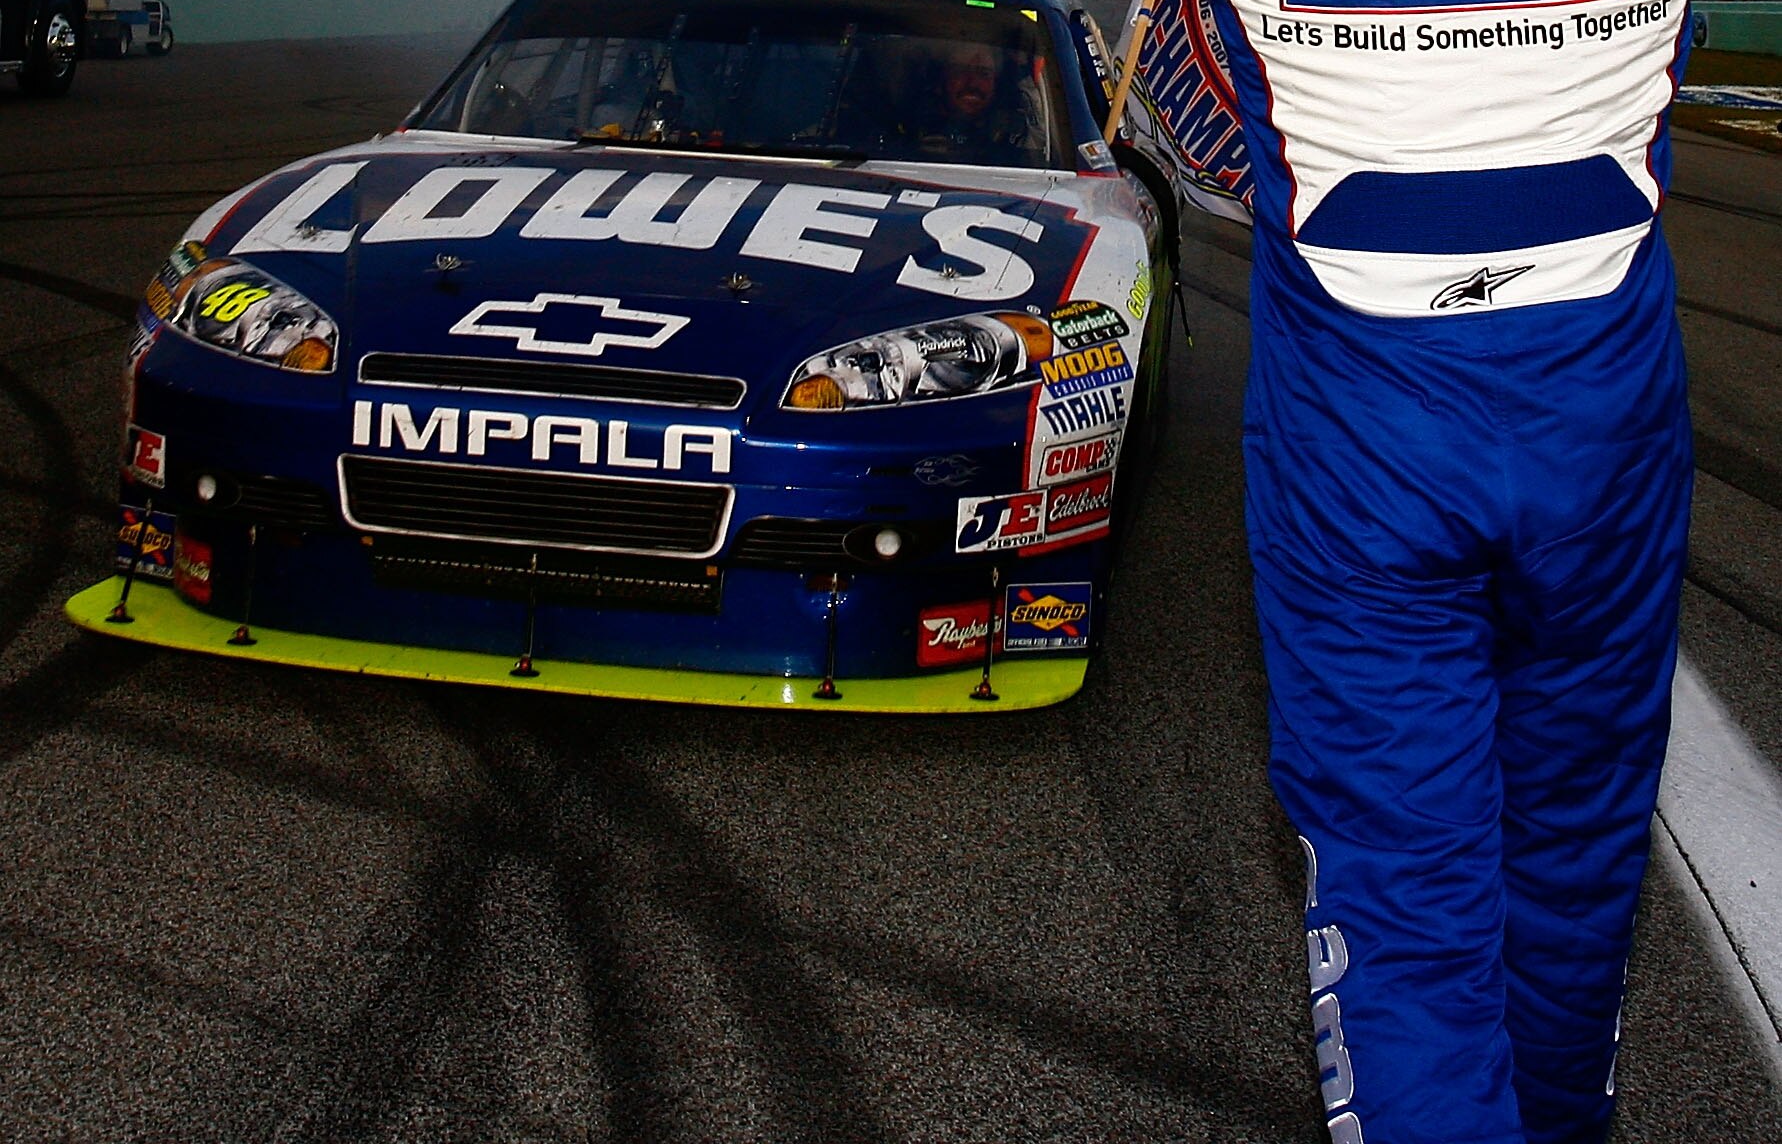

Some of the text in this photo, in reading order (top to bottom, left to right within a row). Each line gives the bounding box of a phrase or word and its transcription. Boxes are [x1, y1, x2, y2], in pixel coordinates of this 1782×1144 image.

[1261, 14, 1323, 46] Let's
[1334, 23, 1406, 51] Build
[1416, 19, 1564, 51] Something
[231, 160, 1045, 301] LOWE'S
[200, 283, 271, 322] 48
[1052, 309, 1118, 337] Gatorback
[1067, 324, 1125, 348] BELTS
[918, 336, 967, 355] Hendrick
[1040, 342, 1124, 386] MOOG
[1039, 386, 1126, 436] MAHLE
[352, 399, 732, 473] IMPALA
[1045, 438, 1106, 477] COMP
[957, 493, 1044, 548] JE
[1049, 483, 1109, 523] Edelbrock
[987, 533, 1043, 549] PISTONS
[1014, 604, 1084, 621] SUNOCO
